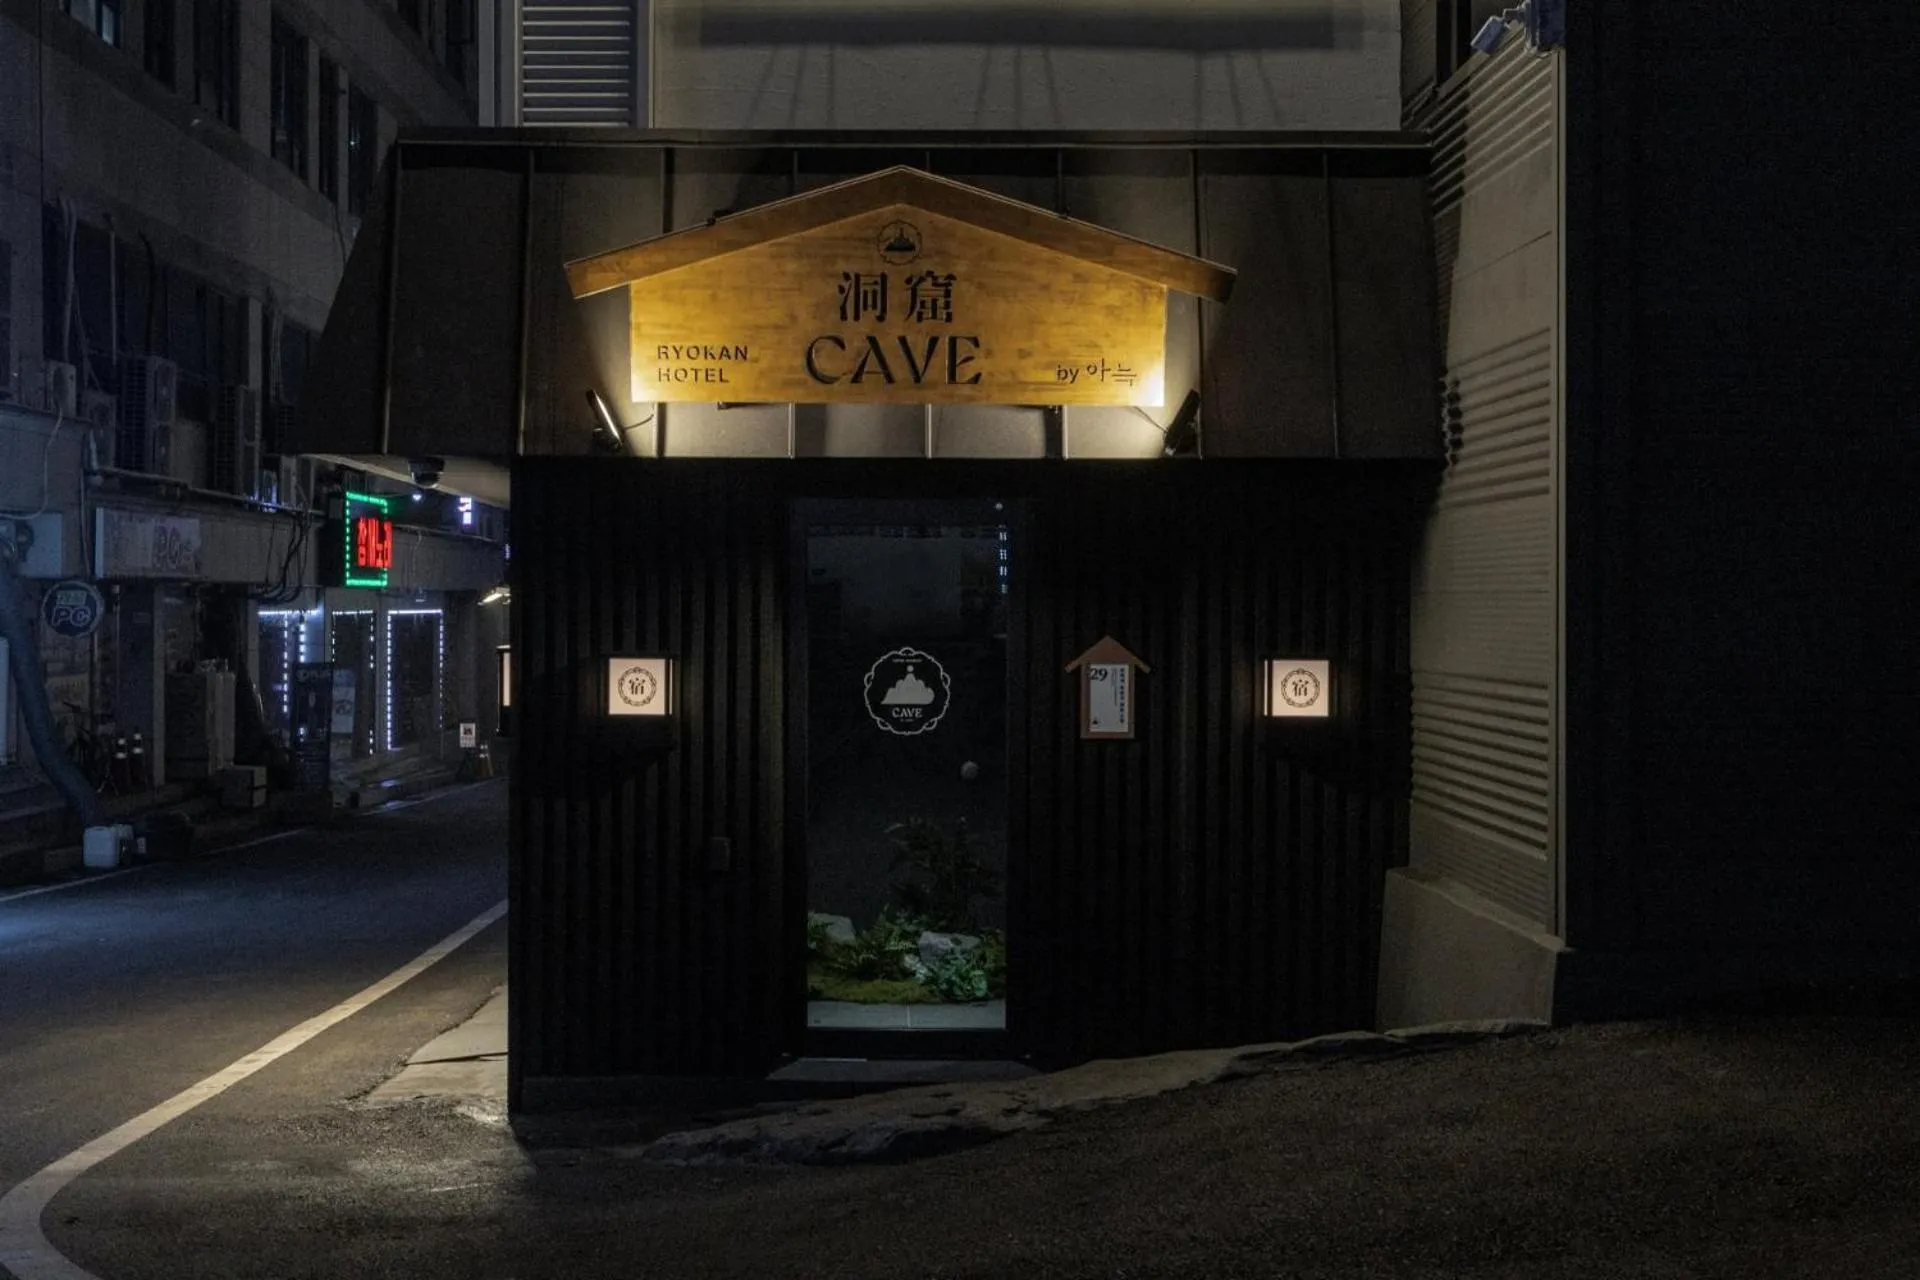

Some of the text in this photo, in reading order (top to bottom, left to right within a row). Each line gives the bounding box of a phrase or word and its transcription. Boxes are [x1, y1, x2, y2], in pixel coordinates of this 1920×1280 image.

[837, 270, 957, 323] 洞窟
[657, 344, 749, 362] RYOKAN
[805, 334, 983, 386] CAVE
[657, 366, 730, 384] HOTEL
[1056, 357, 1138, 387] by 아늑
[1090, 667, 1108, 682] 29
[891, 706, 923, 719] CAVE
